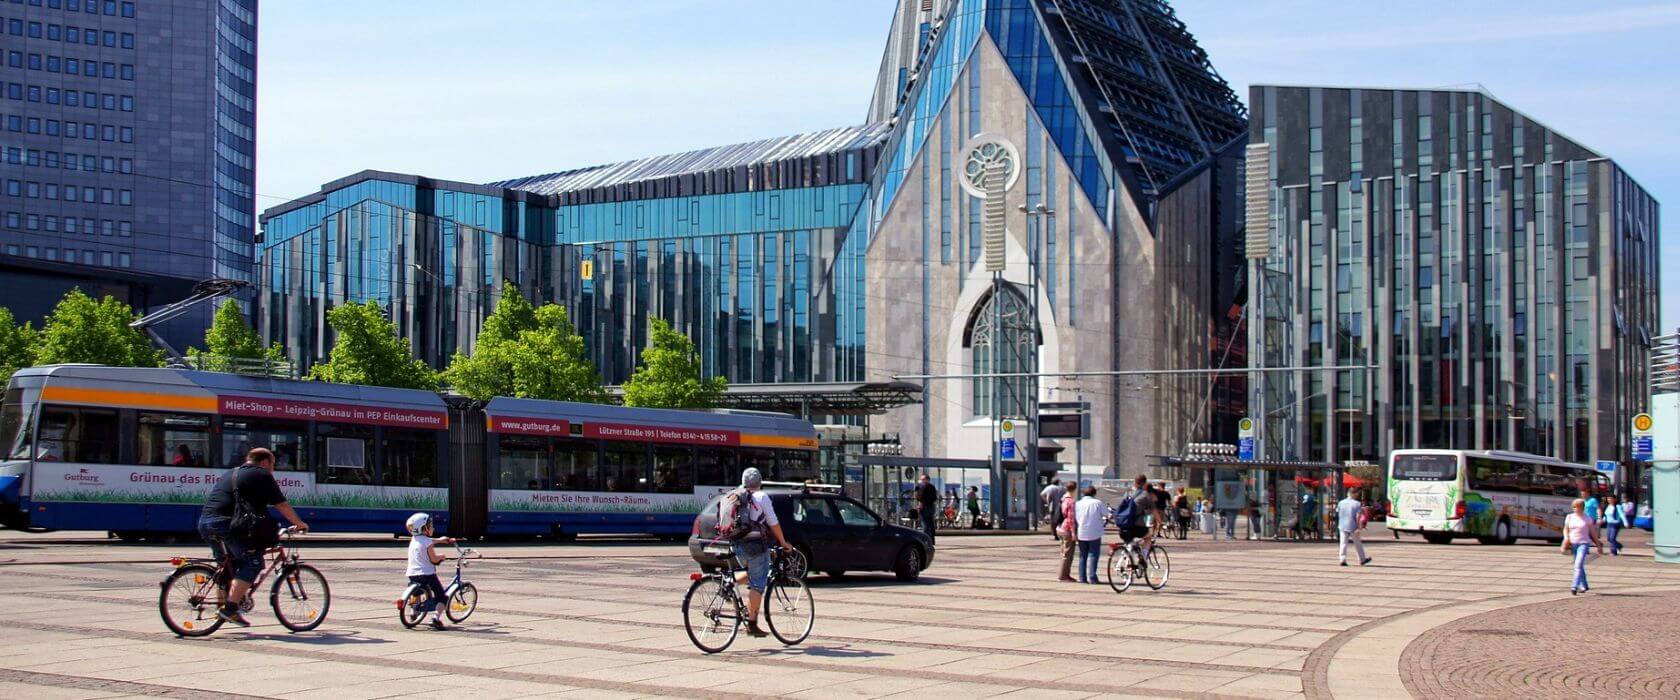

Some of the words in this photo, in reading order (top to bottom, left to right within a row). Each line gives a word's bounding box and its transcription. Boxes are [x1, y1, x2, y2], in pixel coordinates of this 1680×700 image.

[225, 400, 273, 413] Miet-Shop
[285, 405, 351, 418] Leipzig-Grünau
[353, 409, 364, 419] im
[367, 411, 381, 420] PEP
[383, 412, 440, 424] Einkaufscenter
[501, 421, 560, 432] www.gutburg.de
[599, 426, 622, 436] Lützner
[624, 428, 644, 437] Straße
[660, 430, 681, 439] Telefon
[64, 473, 99, 482] Gutburg
[130, 472, 175, 483] Grünau
[180, 474, 200, 484] das
[532, 494, 559, 503] Mieten
[561, 494, 573, 503] Sie
[575, 495, 590, 503] Ihre
[592, 495, 651, 505] Wunsch-Räume.
